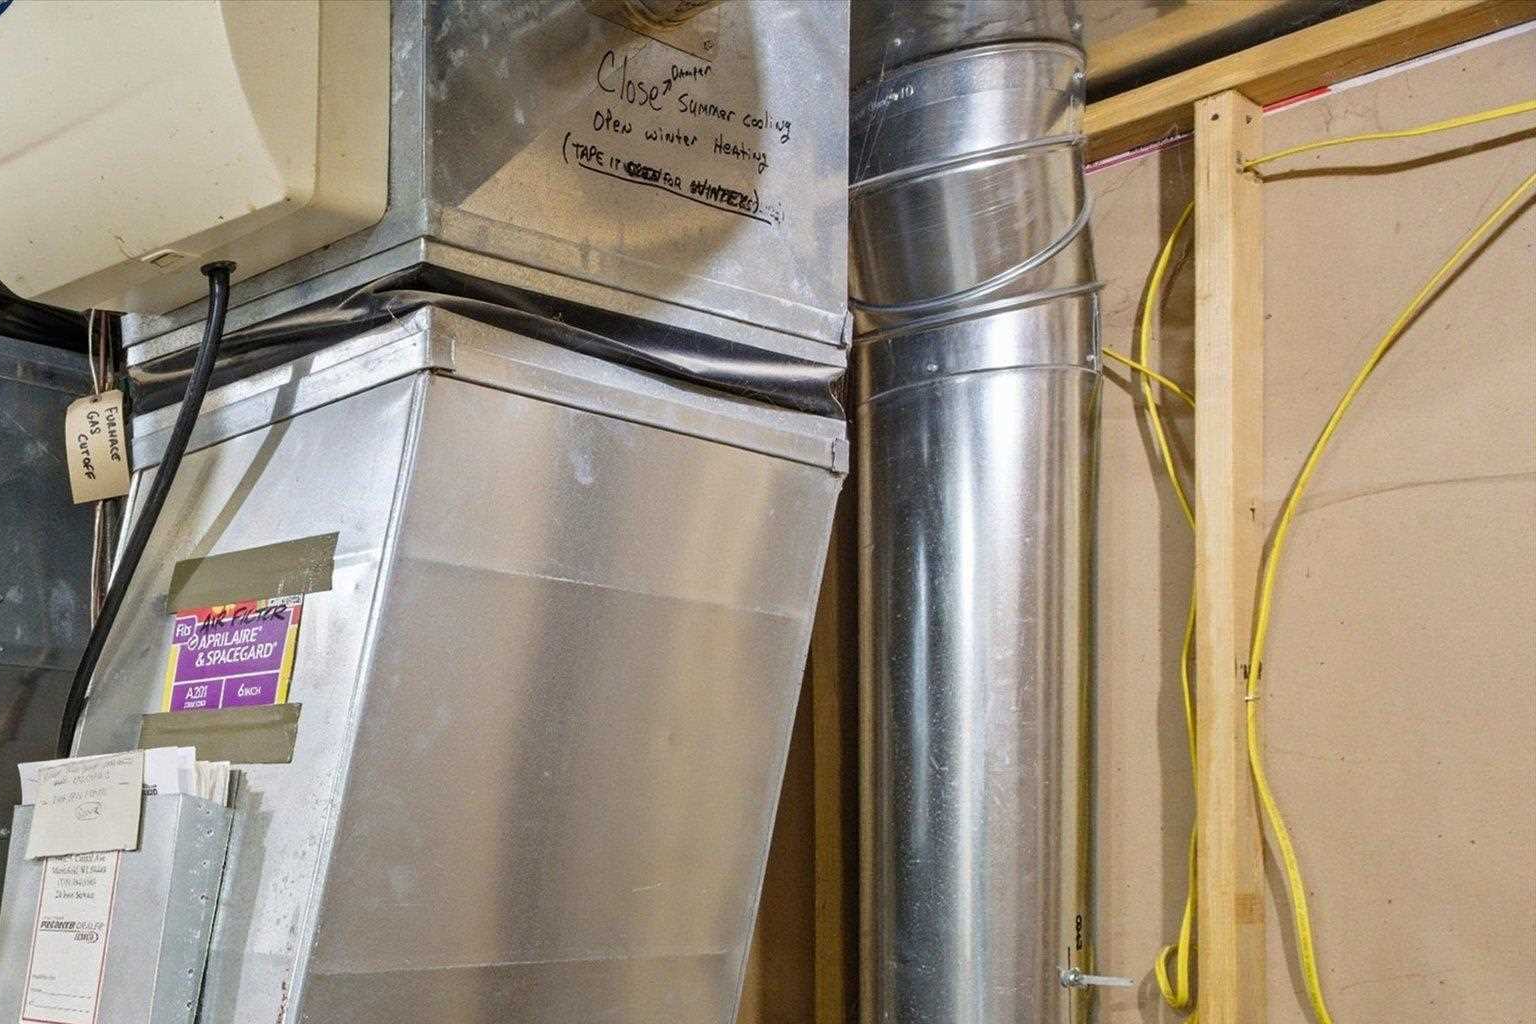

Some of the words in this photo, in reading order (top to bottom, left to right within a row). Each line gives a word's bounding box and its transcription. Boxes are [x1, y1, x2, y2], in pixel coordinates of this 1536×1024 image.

[597, 50, 662, 111] Close
[86, 411, 101, 435] GAS
[105, 406, 121, 462] FURNACE
[78, 434, 96, 480] CUTOFF
[201, 611, 224, 633] AIR
[231, 604, 288, 627] FILTER
[198, 627, 260, 650] APRILAIRE
[196, 652, 206, 667] &
[206, 644, 274, 667] SPACEGARD
